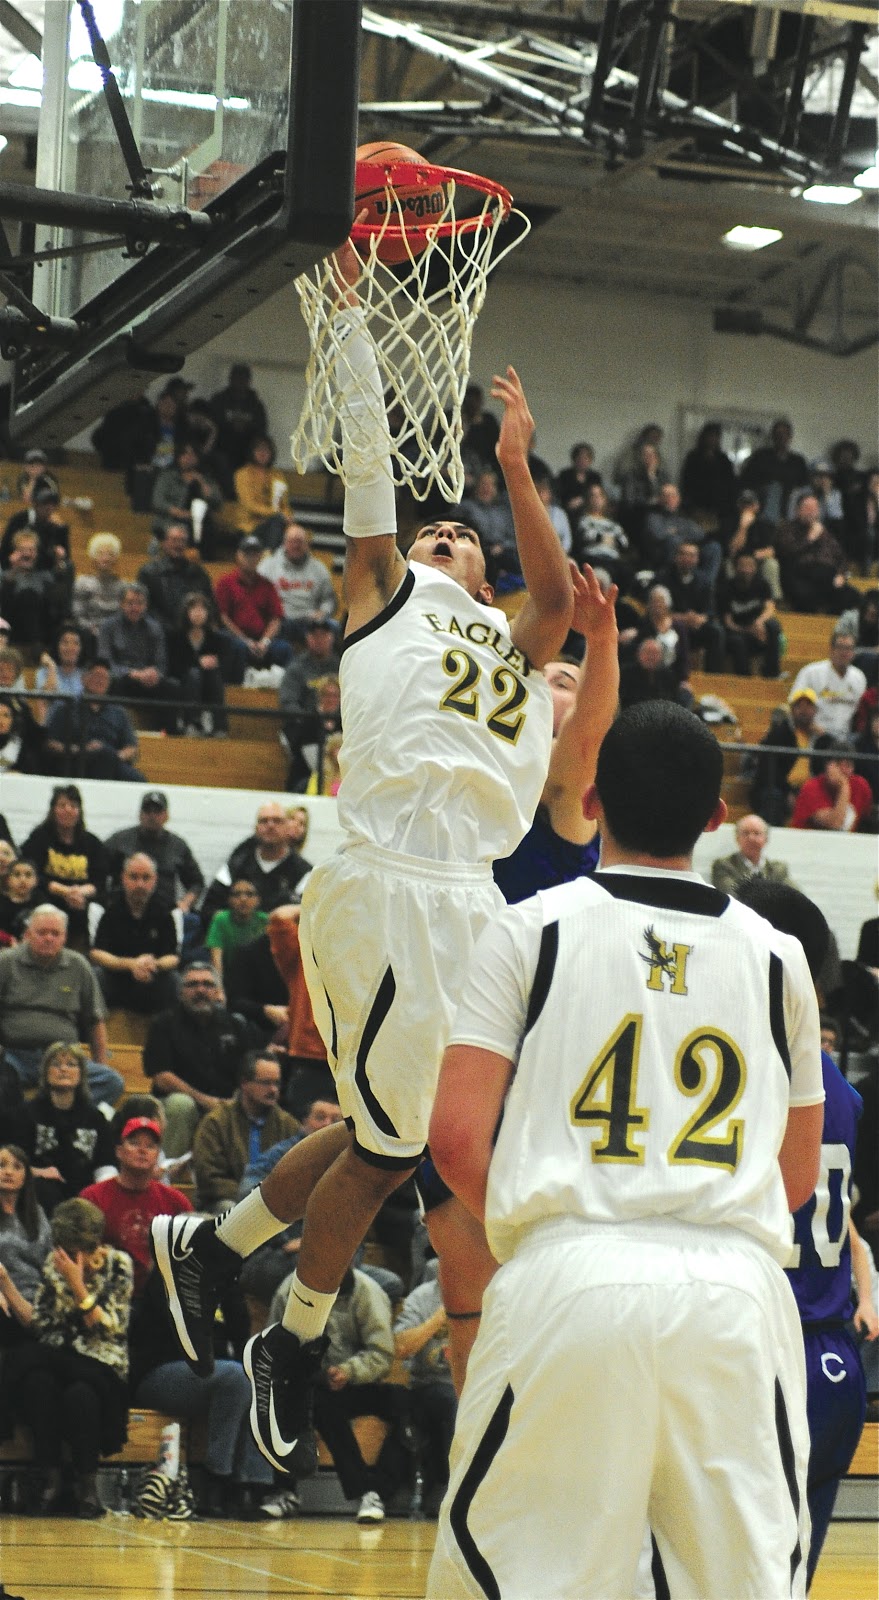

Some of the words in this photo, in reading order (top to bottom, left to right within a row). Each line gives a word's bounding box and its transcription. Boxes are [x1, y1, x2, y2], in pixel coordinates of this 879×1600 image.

[374, 192, 443, 217] Wilson
[439, 647, 529, 747] 22
[646, 940, 690, 996] H
[570, 1012, 747, 1177] 42
[783, 1143, 851, 1268] 0
[821, 1352, 846, 1383] C
